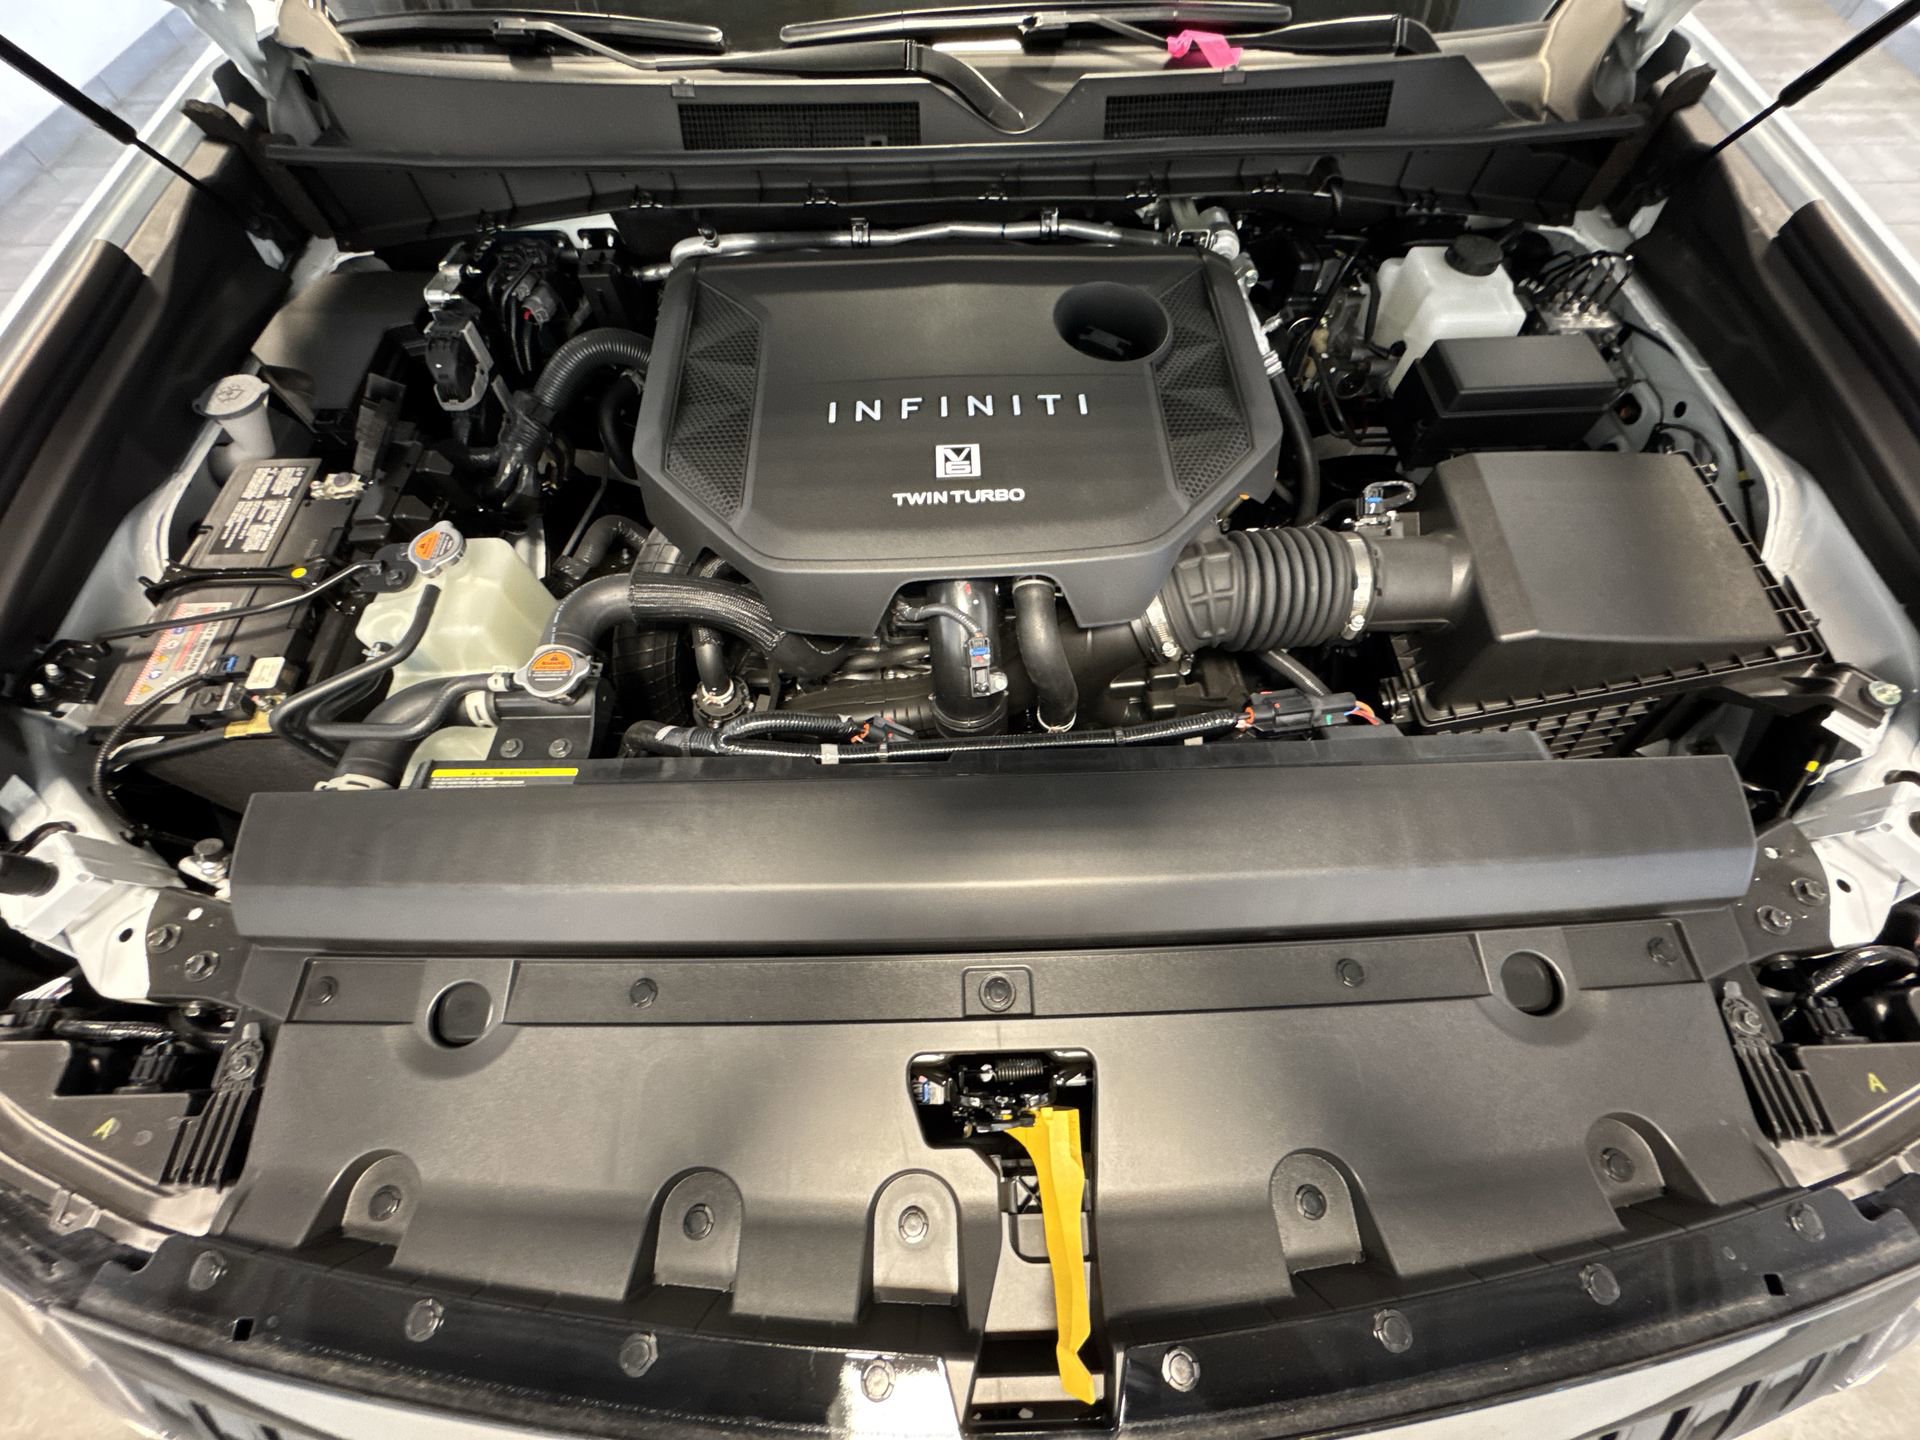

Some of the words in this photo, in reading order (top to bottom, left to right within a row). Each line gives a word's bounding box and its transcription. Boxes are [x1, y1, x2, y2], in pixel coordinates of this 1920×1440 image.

[828, 393, 1088, 424] INFINITI
[892, 490, 948, 506] TWIN
[949, 487, 1026, 504] TURBO
[1867, 1071, 1888, 1094] A
